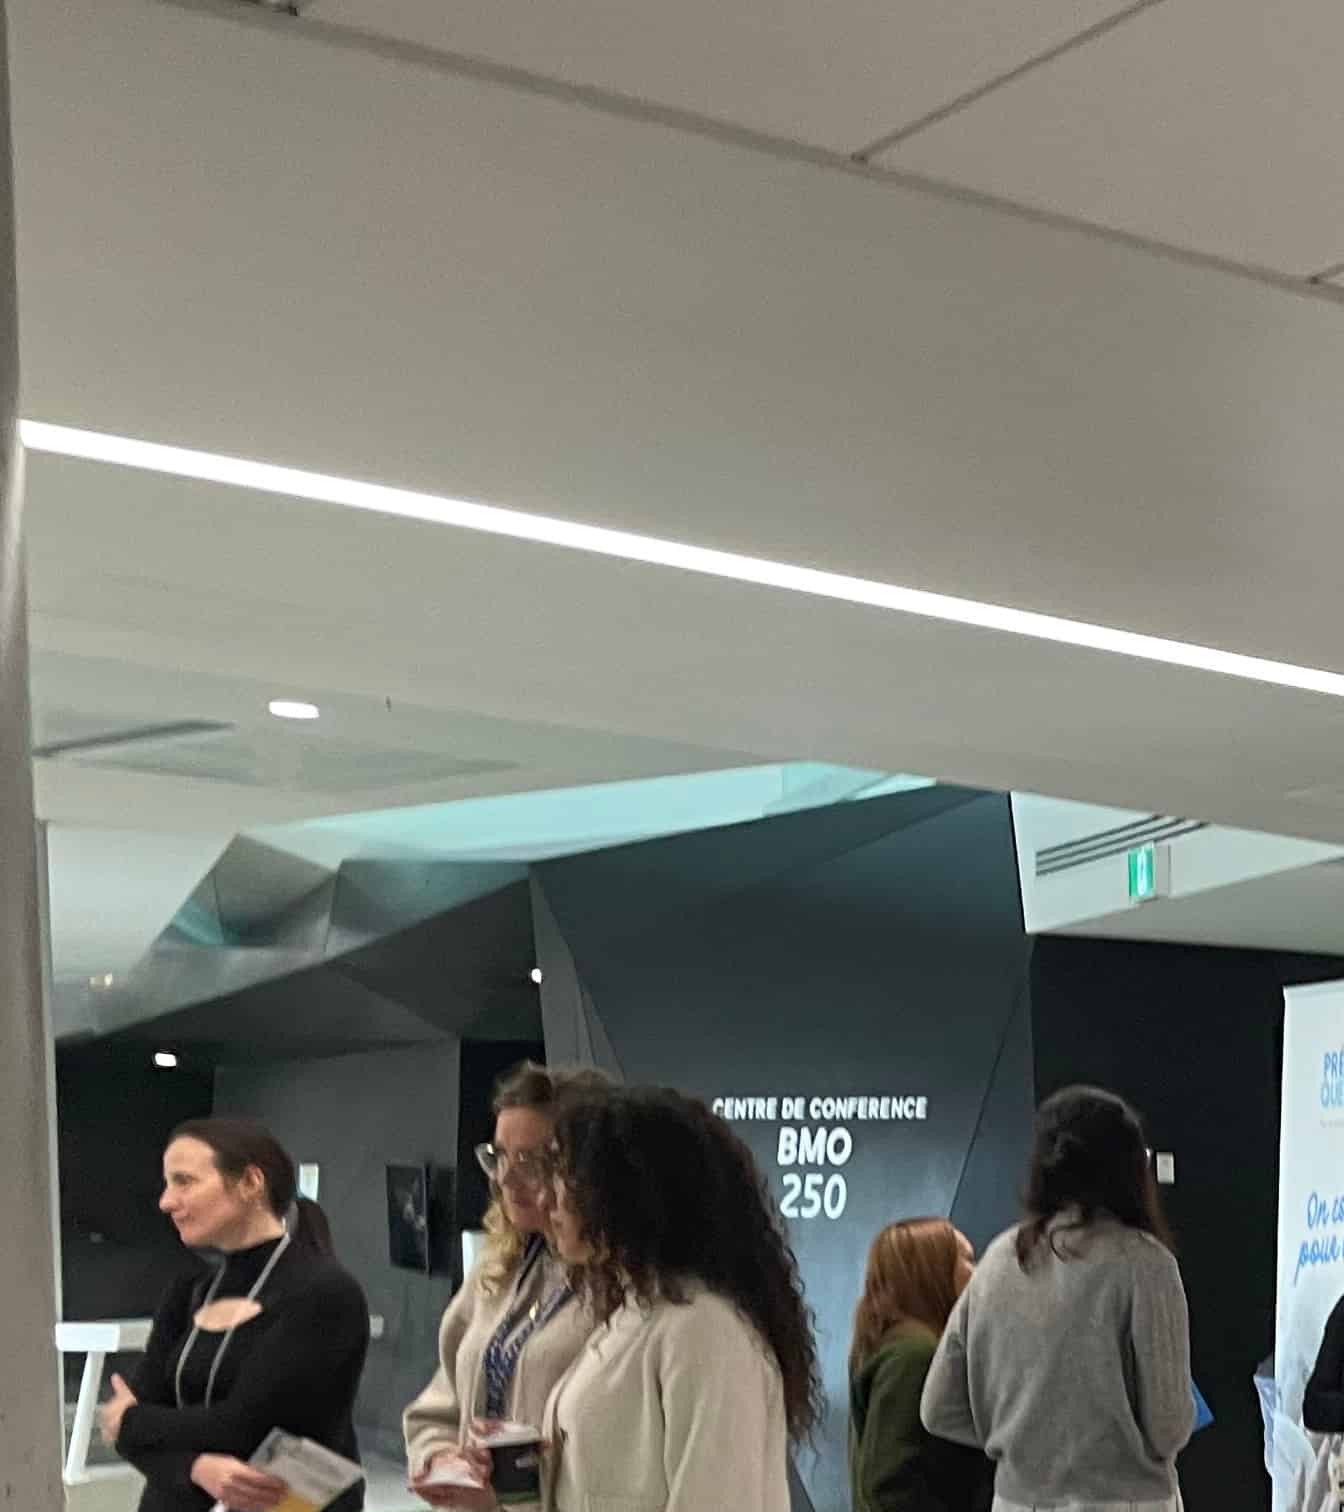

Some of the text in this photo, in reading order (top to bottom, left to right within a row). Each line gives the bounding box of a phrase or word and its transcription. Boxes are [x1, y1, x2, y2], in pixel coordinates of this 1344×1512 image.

[712, 1096, 778, 1120] CENTRE
[781, 1096, 806, 1120] DE
[777, 1126, 853, 1166] BMO
[779, 1172, 848, 1220] 250
